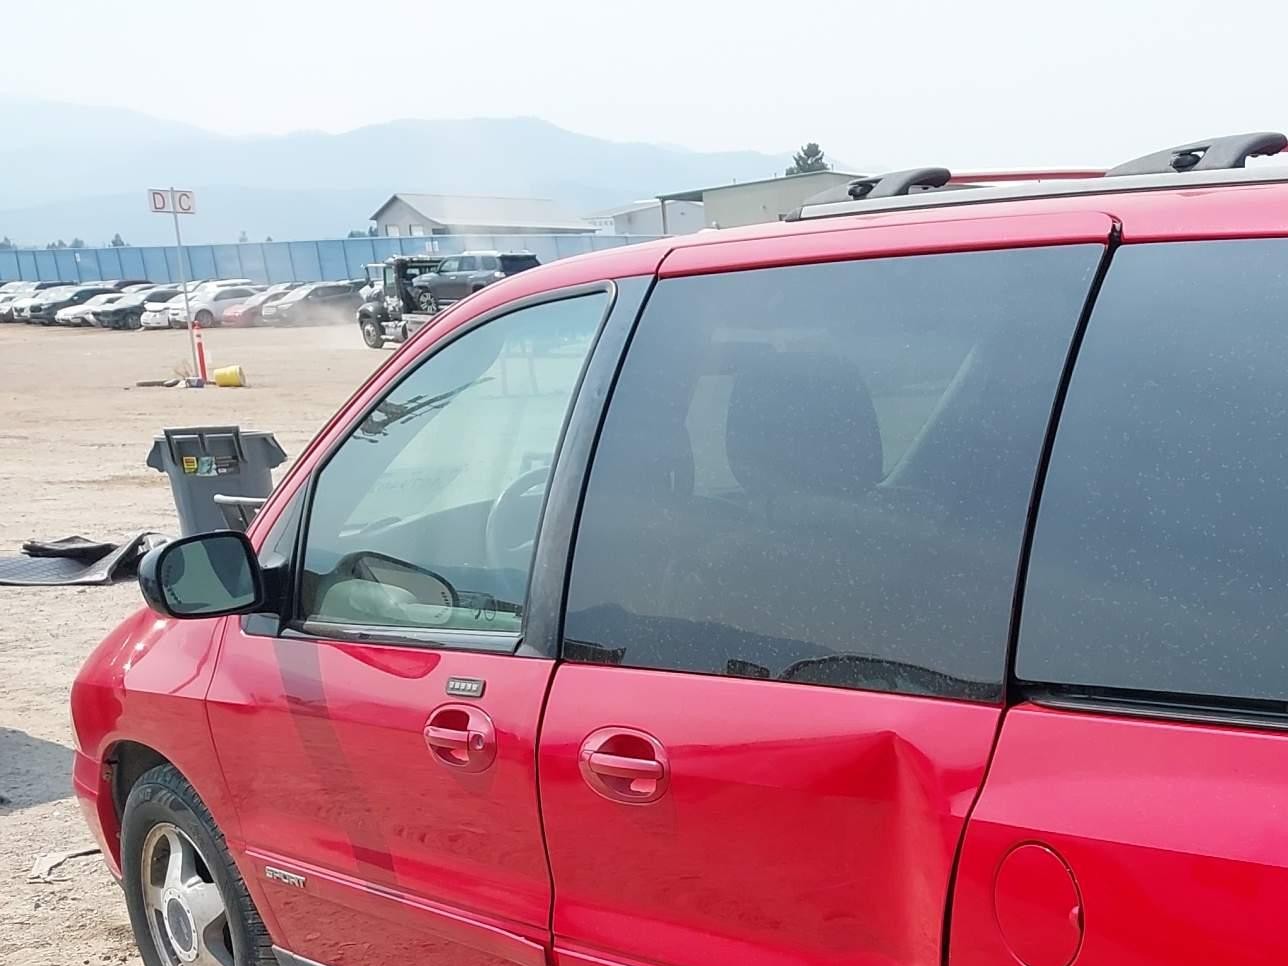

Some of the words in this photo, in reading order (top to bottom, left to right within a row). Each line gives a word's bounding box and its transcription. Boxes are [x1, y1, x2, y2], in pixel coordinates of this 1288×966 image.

[152, 192, 165, 209] D
[179, 193, 191, 211] C
[265, 865, 306, 889] SPORT
